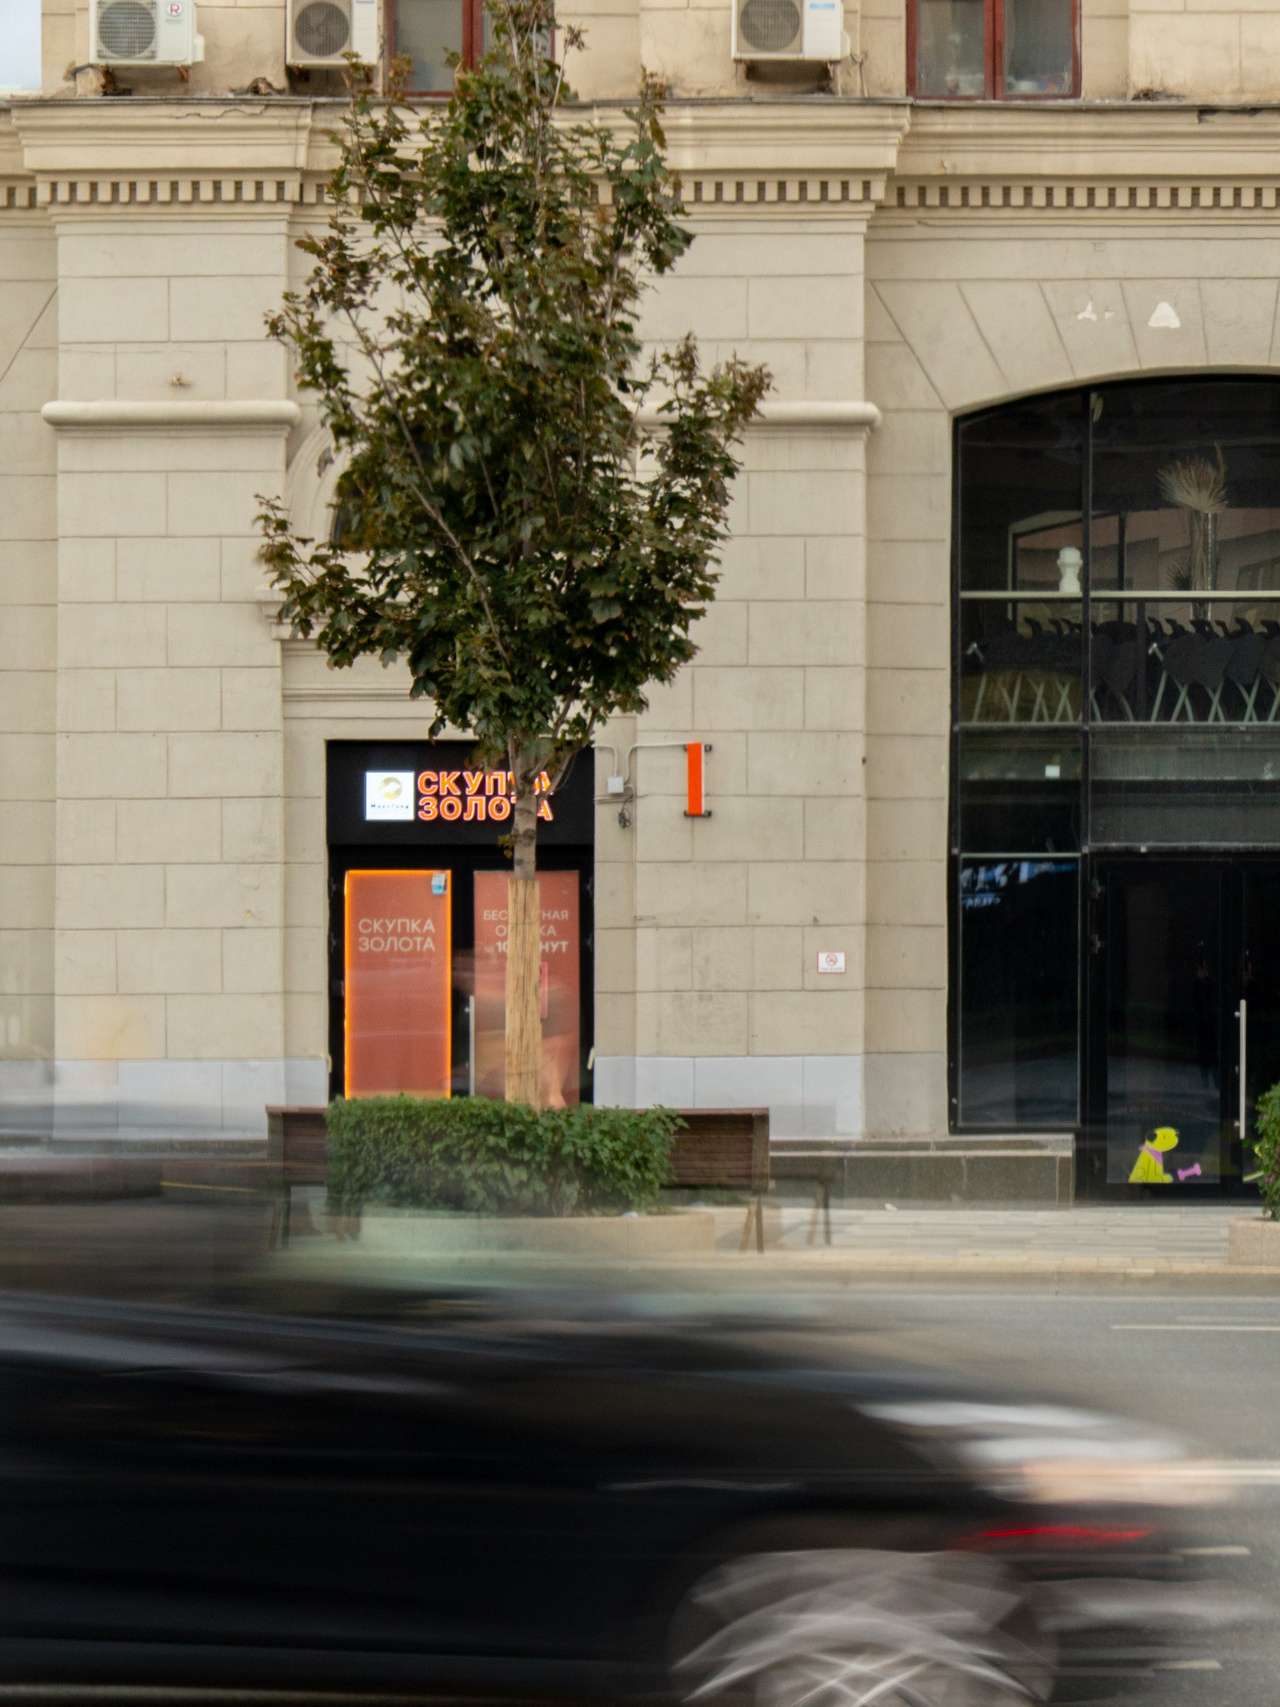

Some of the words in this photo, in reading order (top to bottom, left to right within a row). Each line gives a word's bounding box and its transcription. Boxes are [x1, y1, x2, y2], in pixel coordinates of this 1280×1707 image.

[417, 771, 553, 795] СКУПА
[417, 796, 554, 821] ЗОЛОА
[358, 918, 436, 934] СКУПКА
[358, 936, 436, 952] ЗОЛОТА
